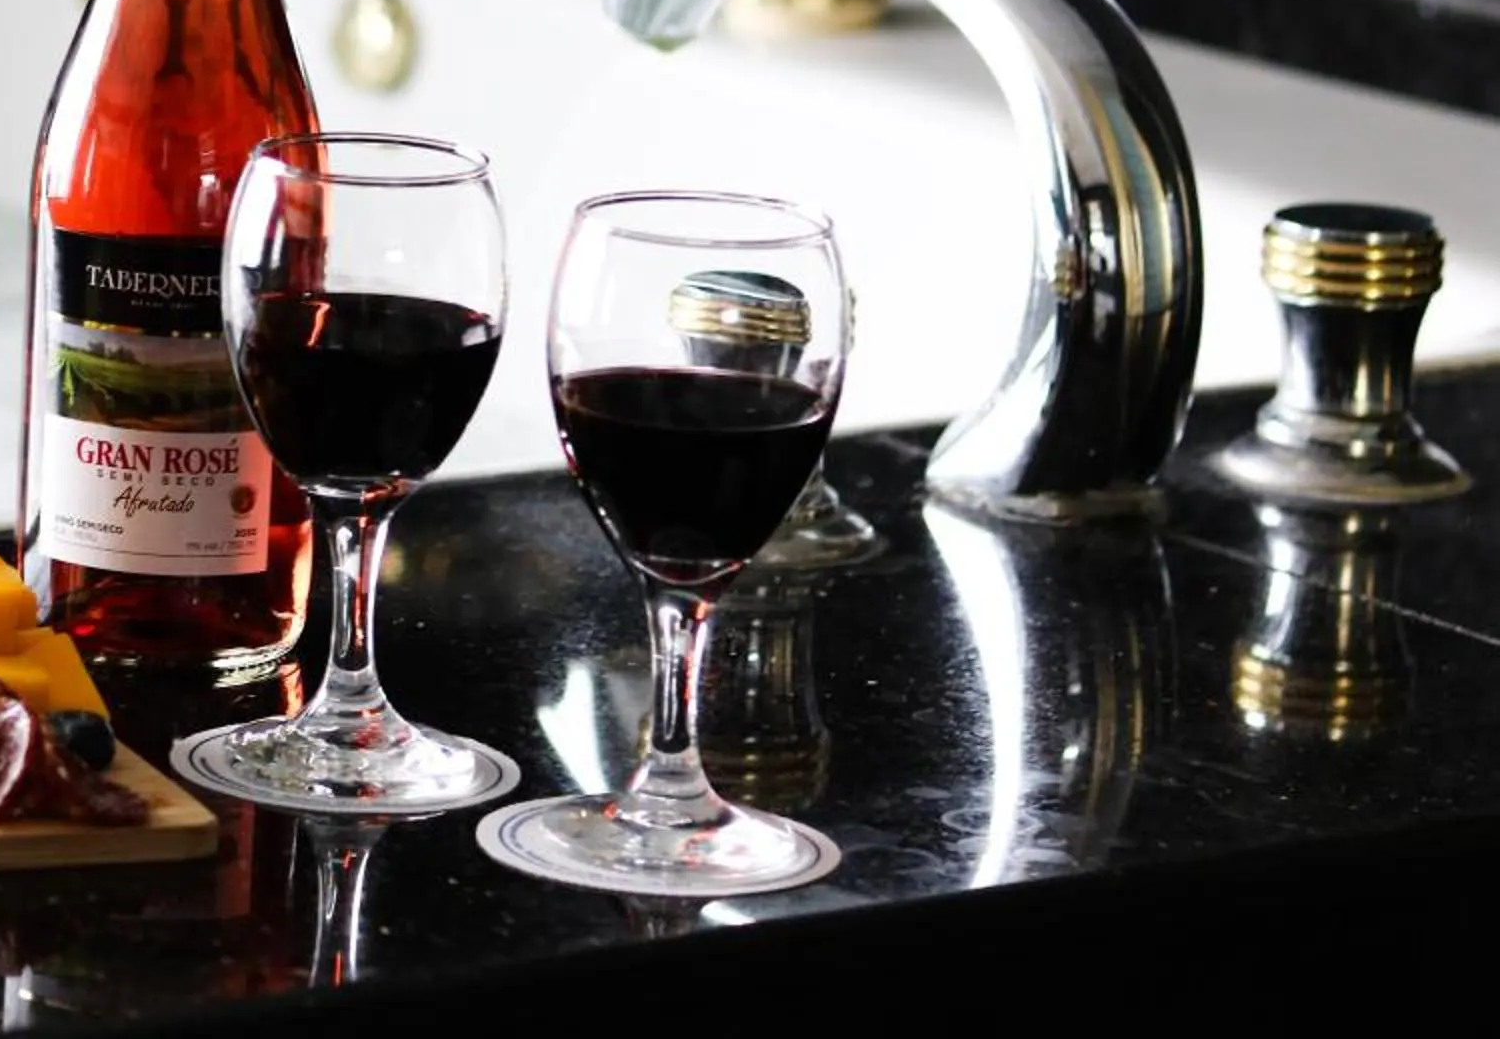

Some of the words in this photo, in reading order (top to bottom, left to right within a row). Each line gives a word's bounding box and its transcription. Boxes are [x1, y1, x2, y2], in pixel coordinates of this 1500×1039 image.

[85, 264, 223, 299] TABERNER
[76, 436, 156, 474] GRAN
[162, 437, 240, 475] ROSÉ
[96, 468, 143, 483] SEMI
[161, 475, 216, 487] SECO
